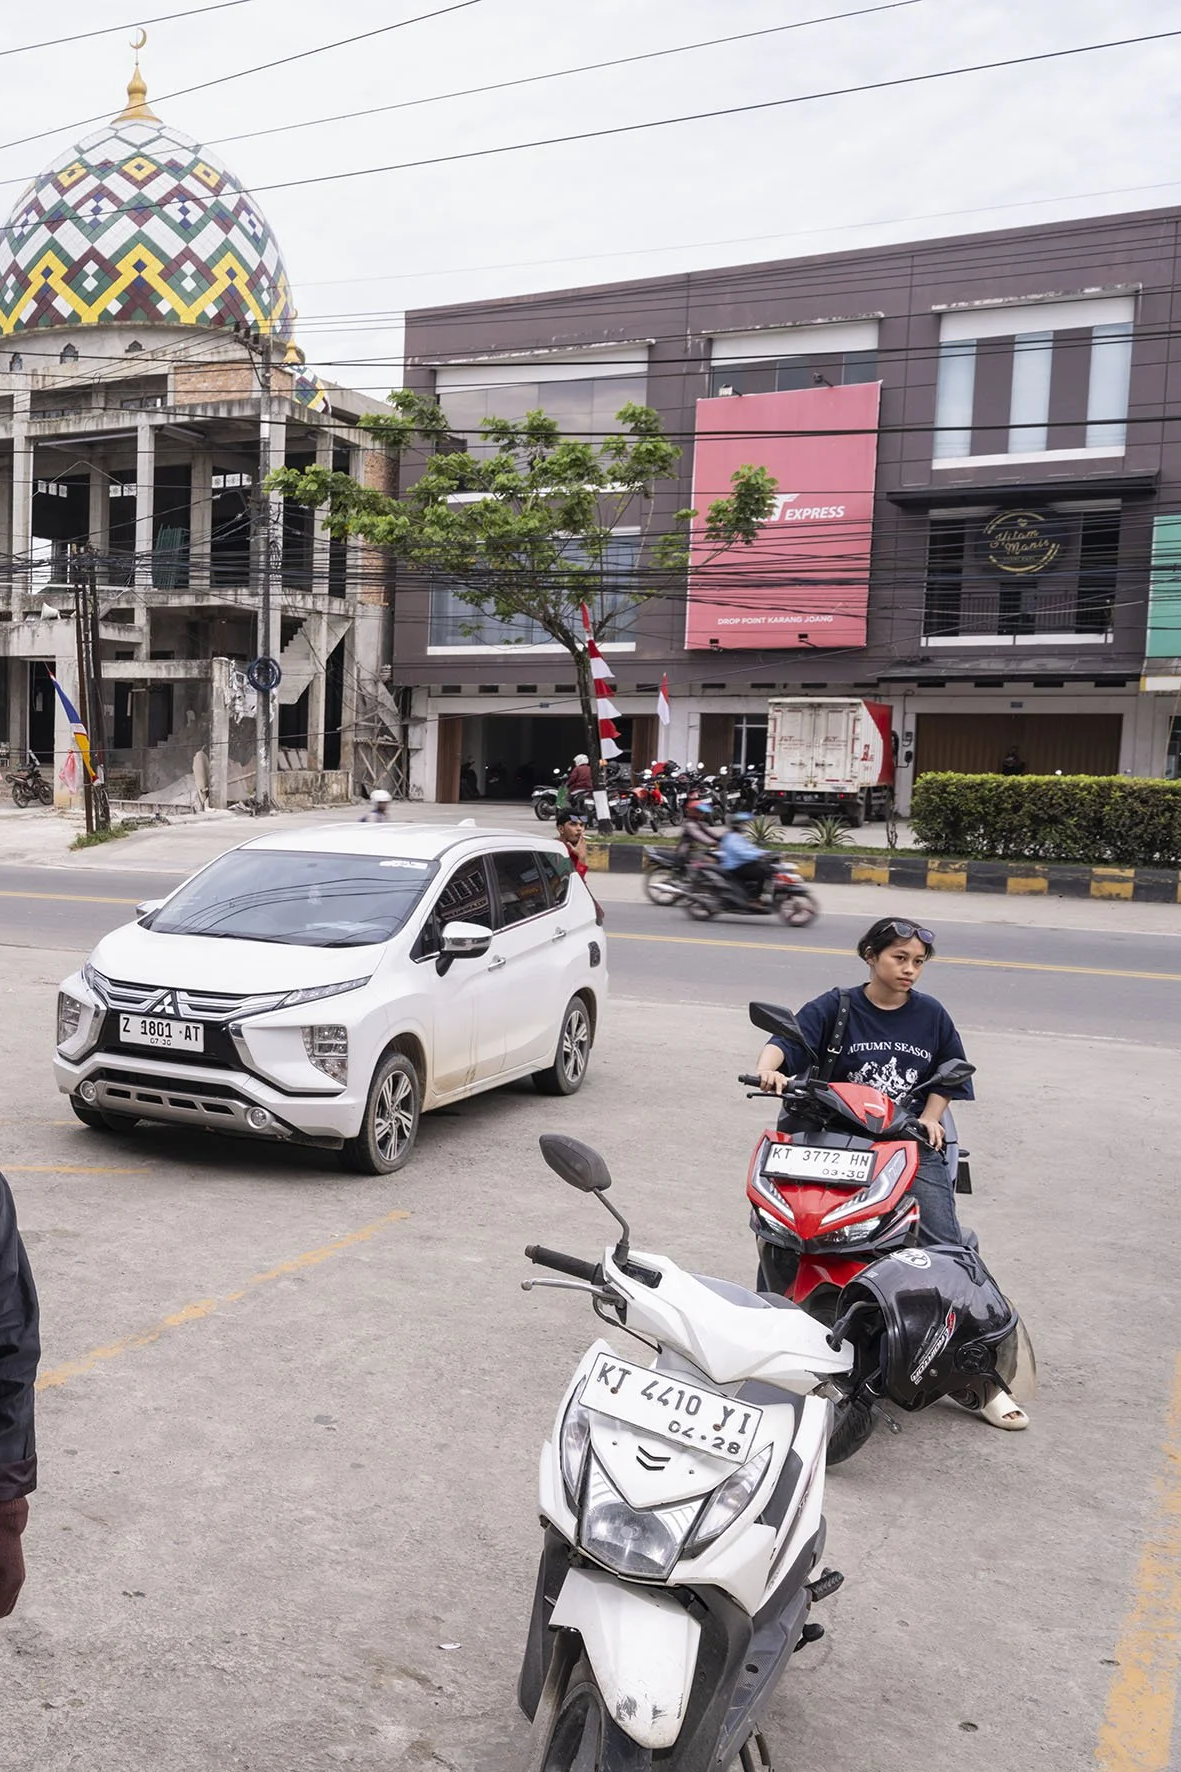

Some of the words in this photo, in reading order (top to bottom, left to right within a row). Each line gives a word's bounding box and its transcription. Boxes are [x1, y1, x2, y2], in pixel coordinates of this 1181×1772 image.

[784, 506, 846, 521] EXPRESS
[990, 530, 1039, 549] Hitam
[1004, 539, 1050, 555] Manis
[742, 617, 766, 625] POINT
[768, 616, 802, 624] KARANG
[804, 615, 833, 623] JOANG
[122, 1017, 130, 1032] Z
[140, 1020, 172, 1038] 1801
[184, 1025, 200, 1041] AT
[847, 1041, 892, 1055] AUTUMN
[772, 1147, 792, 1159] KT
[802, 1150, 841, 1164] 3772
[849, 1154, 870, 1167] HN
[597, 1362, 632, 1389] KT
[640, 1380, 702, 1416] 4410
[719, 1405, 751, 1435] YI
